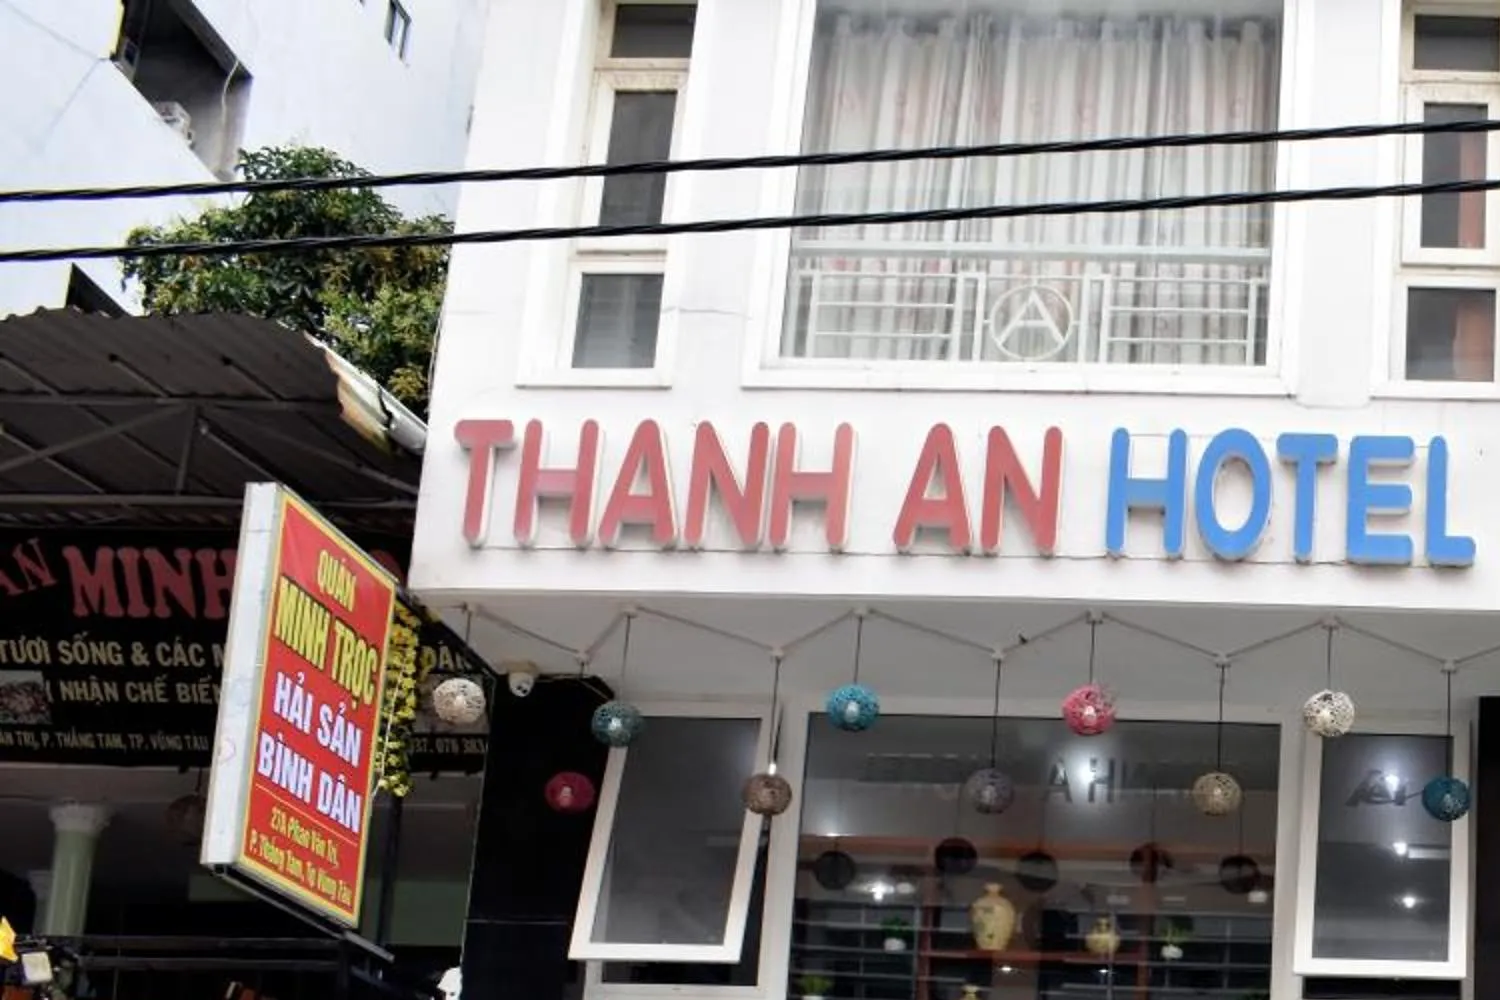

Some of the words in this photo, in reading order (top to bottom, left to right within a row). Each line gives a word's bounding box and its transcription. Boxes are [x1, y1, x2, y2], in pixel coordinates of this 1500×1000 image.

[453, 418, 858, 553] THANH
[892, 422, 1064, 557] AN
[1106, 426, 1477, 567] HOTEL
[62, 545, 238, 619] MINH
[57, 630, 125, 668] SỐNG
[130, 640, 151, 667] &
[155, 635, 207, 668] CÁC
[59, 674, 120, 706] NHẬN
[273, 574, 332, 672] MINH
[331, 619, 379, 710] TRỌC
[273, 671, 314, 735] HẢI
[316, 701, 362, 768] SẢN
[257, 731, 315, 804] BÌNH
[316, 772, 362, 834] DÂN
